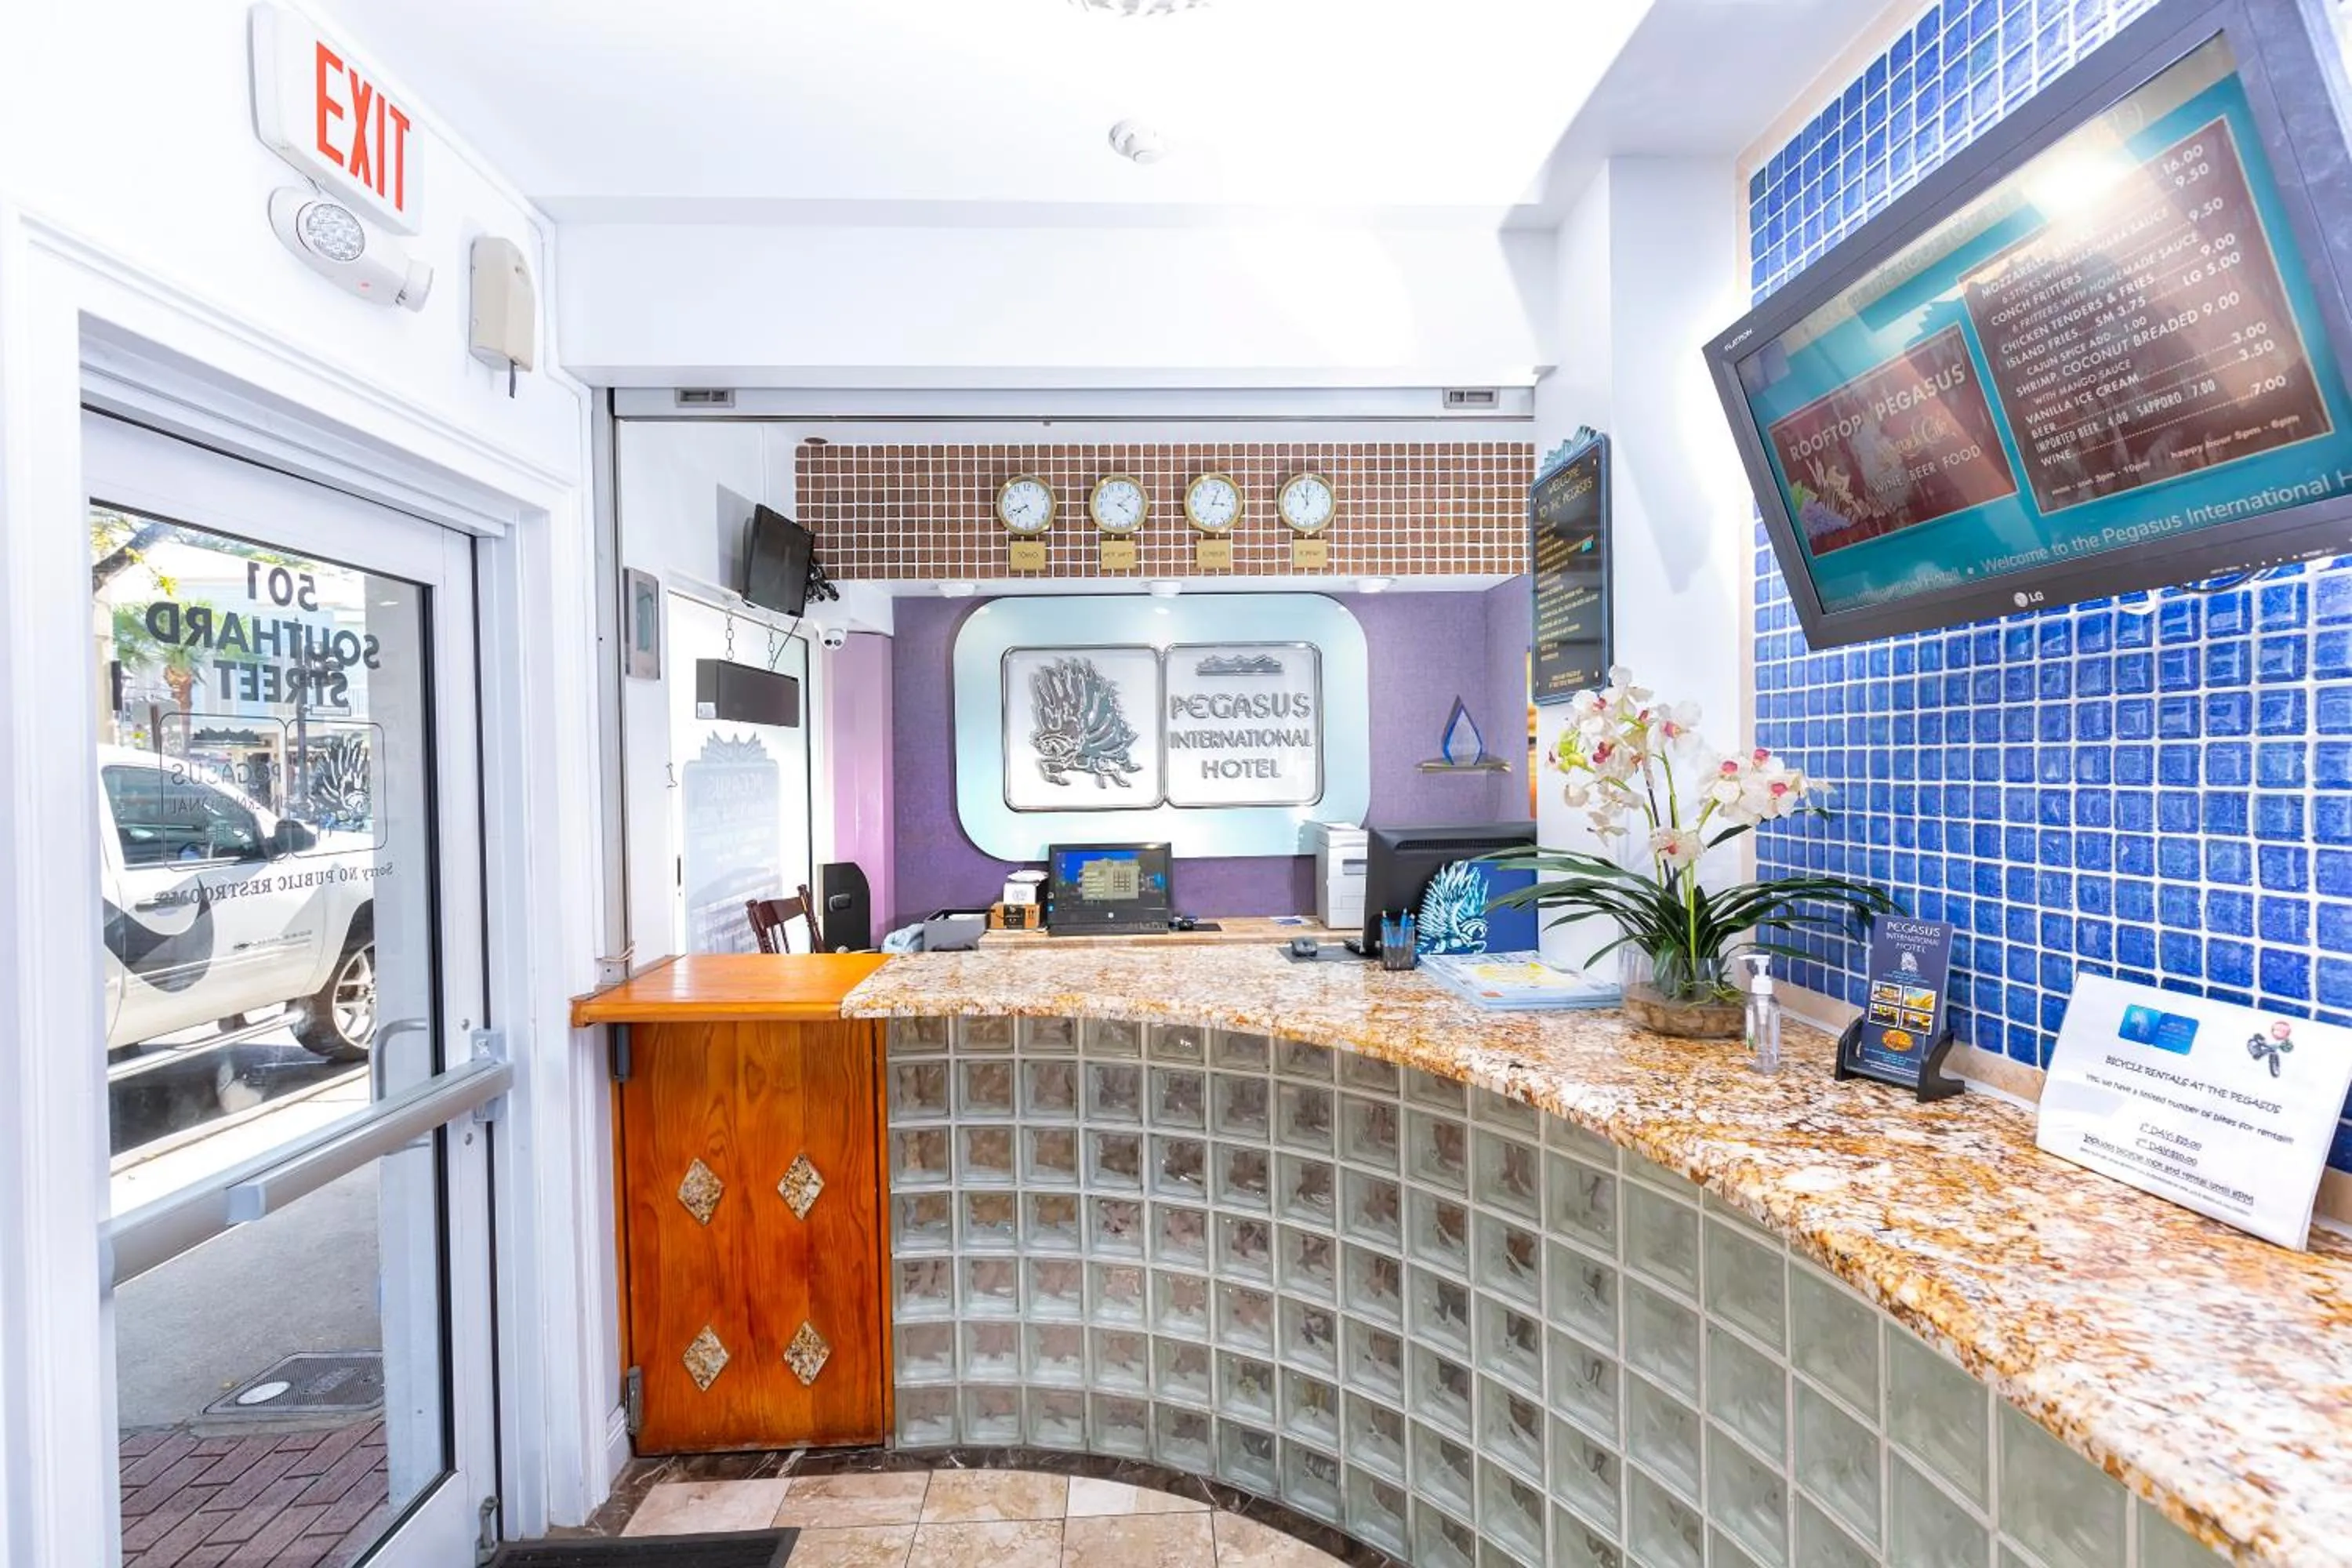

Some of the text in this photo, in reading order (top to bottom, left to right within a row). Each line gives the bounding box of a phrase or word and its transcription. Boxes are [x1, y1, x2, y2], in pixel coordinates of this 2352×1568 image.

[315, 40, 410, 213] EXIT
[2176, 162, 2209, 188] 9.50
[1991, 197, 2224, 326] CONCH FRITTERS 9.50
[2009, 280, 2041, 300] STICKS
[2042, 261, 2068, 281] WITH
[2129, 208, 2169, 233] SAUCE
[2019, 301, 2060, 330] FRITTERS
[2060, 286, 2087, 310] WITH
[2089, 256, 2155, 296] HOMEMADE
[2158, 230, 2199, 263] SAUCE
[2002, 232, 2236, 354] CHICKEN TENDERS & FRIES 9.00
[2006, 251, 2241, 370] ISLAND FRIES SM 3.75 LG 5.00
[2027, 316, 2147, 376] CAJUN SPICE ADD 1.00
[2063, 339, 2129, 377] COCONUT
[2133, 309, 2198, 347] BREADED
[2202, 291, 2240, 316] 9.00
[2026, 321, 2267, 424] VANILLA ICE CREAM 3.00
[2031, 339, 2274, 440] BEER 3.50
[2034, 358, 2132, 405] WITH MANGO SAUCE
[1790, 363, 1965, 463] ROOFTOP PEGASUS
[2035, 430, 2077, 452] IMPORTED
[2077, 422, 2099, 439] BEER
[2136, 391, 2182, 417] SAPPORO
[2191, 379, 2216, 398] 7.00
[2041, 376, 2286, 467] WINE 7.00
[1875, 445, 1981, 493] WINE BEER FOOD
[2170, 445, 2203, 459] happy
[2205, 434, 2232, 448] hour
[1538, 505, 1548, 519] TO
[1563, 477, 1593, 504] PEGASUS
[1547, 463, 1581, 495] WELCOME
[1980, 547, 2049, 574] Welcome
[2051, 539, 2068, 556] to
[2070, 535, 2100, 551] the
[2102, 514, 2183, 543] Pegasus
[2186, 474, 2332, 525] International
[2029, 591, 2044, 603] LG
[1169, 692, 1311, 720] PEGASUS
[1168, 729, 1313, 749] INTERNATIONAL
[1201, 759, 1281, 779] HOTEL
[1887, 921, 1940, 937] PEGASUS
[1895, 942, 1926, 953] HOTEL
[2102, 1079, 2113, 1087] we
[2114, 1080, 2132, 1094] have
[2140, 1089, 2166, 1105] limited
[2168, 1098, 2198, 1114] number
[2201, 1109, 2212, 1119] of
[2213, 1112, 2238, 1127] bikes
[2239, 1121, 2255, 1132] for
[2106, 1055, 2282, 1114] BICYCLE RENTALS AT THE PEGASUS
[2165, 1165, 2180, 1177] and
